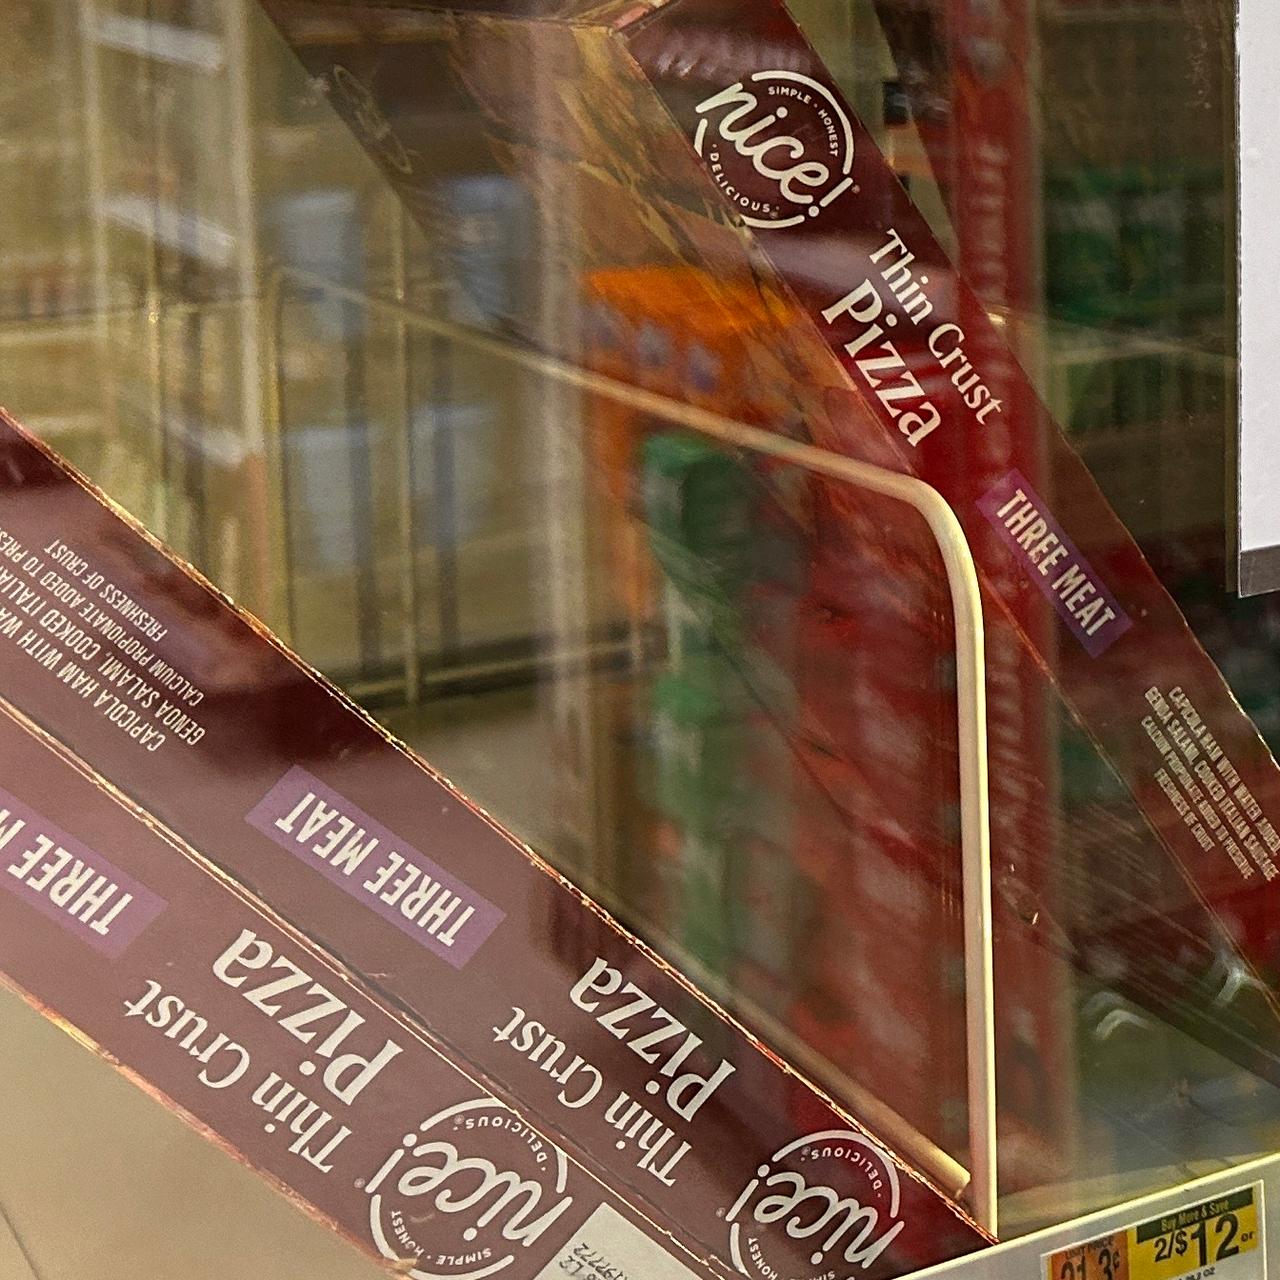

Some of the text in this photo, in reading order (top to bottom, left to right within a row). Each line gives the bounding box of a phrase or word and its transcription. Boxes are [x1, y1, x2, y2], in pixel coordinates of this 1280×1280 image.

[695, 83, 854, 219] nice!
[767, 85, 840, 158] SIMPLE HONEST
[708, 151, 772, 215] DELICIOUS
[821, 278, 941, 449] Pizza
[869, 228, 1004, 426] Thin Crust
[21, 556, 44, 577] TO
[39, 571, 85, 607] ADDED
[43, 539, 167, 641] FRESHNESS OF CRUST
[996, 488, 1115, 638] THREE MEAT
[39, 608, 205, 745] GENOA SALAMI, COOKED
[78, 602, 154, 665] PROPIONATE
[148, 659, 203, 706] CALCIUM
[16, 629, 165, 751] CAPICOLA HAM WITH
[7, 835, 137, 938] THREE
[276, 793, 473, 944] THREE MEAT
[214, 931, 399, 1102] Pizza
[571, 959, 732, 1118] Pizza
[125, 980, 350, 1171] Thin Crust
[493, 1007, 689, 1185] Thin Crust
[465, 1097, 555, 1162] DELICIOUS
[811, 1129, 891, 1189] DELICIOUS
[363, 1132, 573, 1249] nice!
[724, 1165, 905, 1270] nice!
[1154, 1213, 1254, 1266] 2/$12 or
[435, 1230, 491, 1280] SIMPLE
